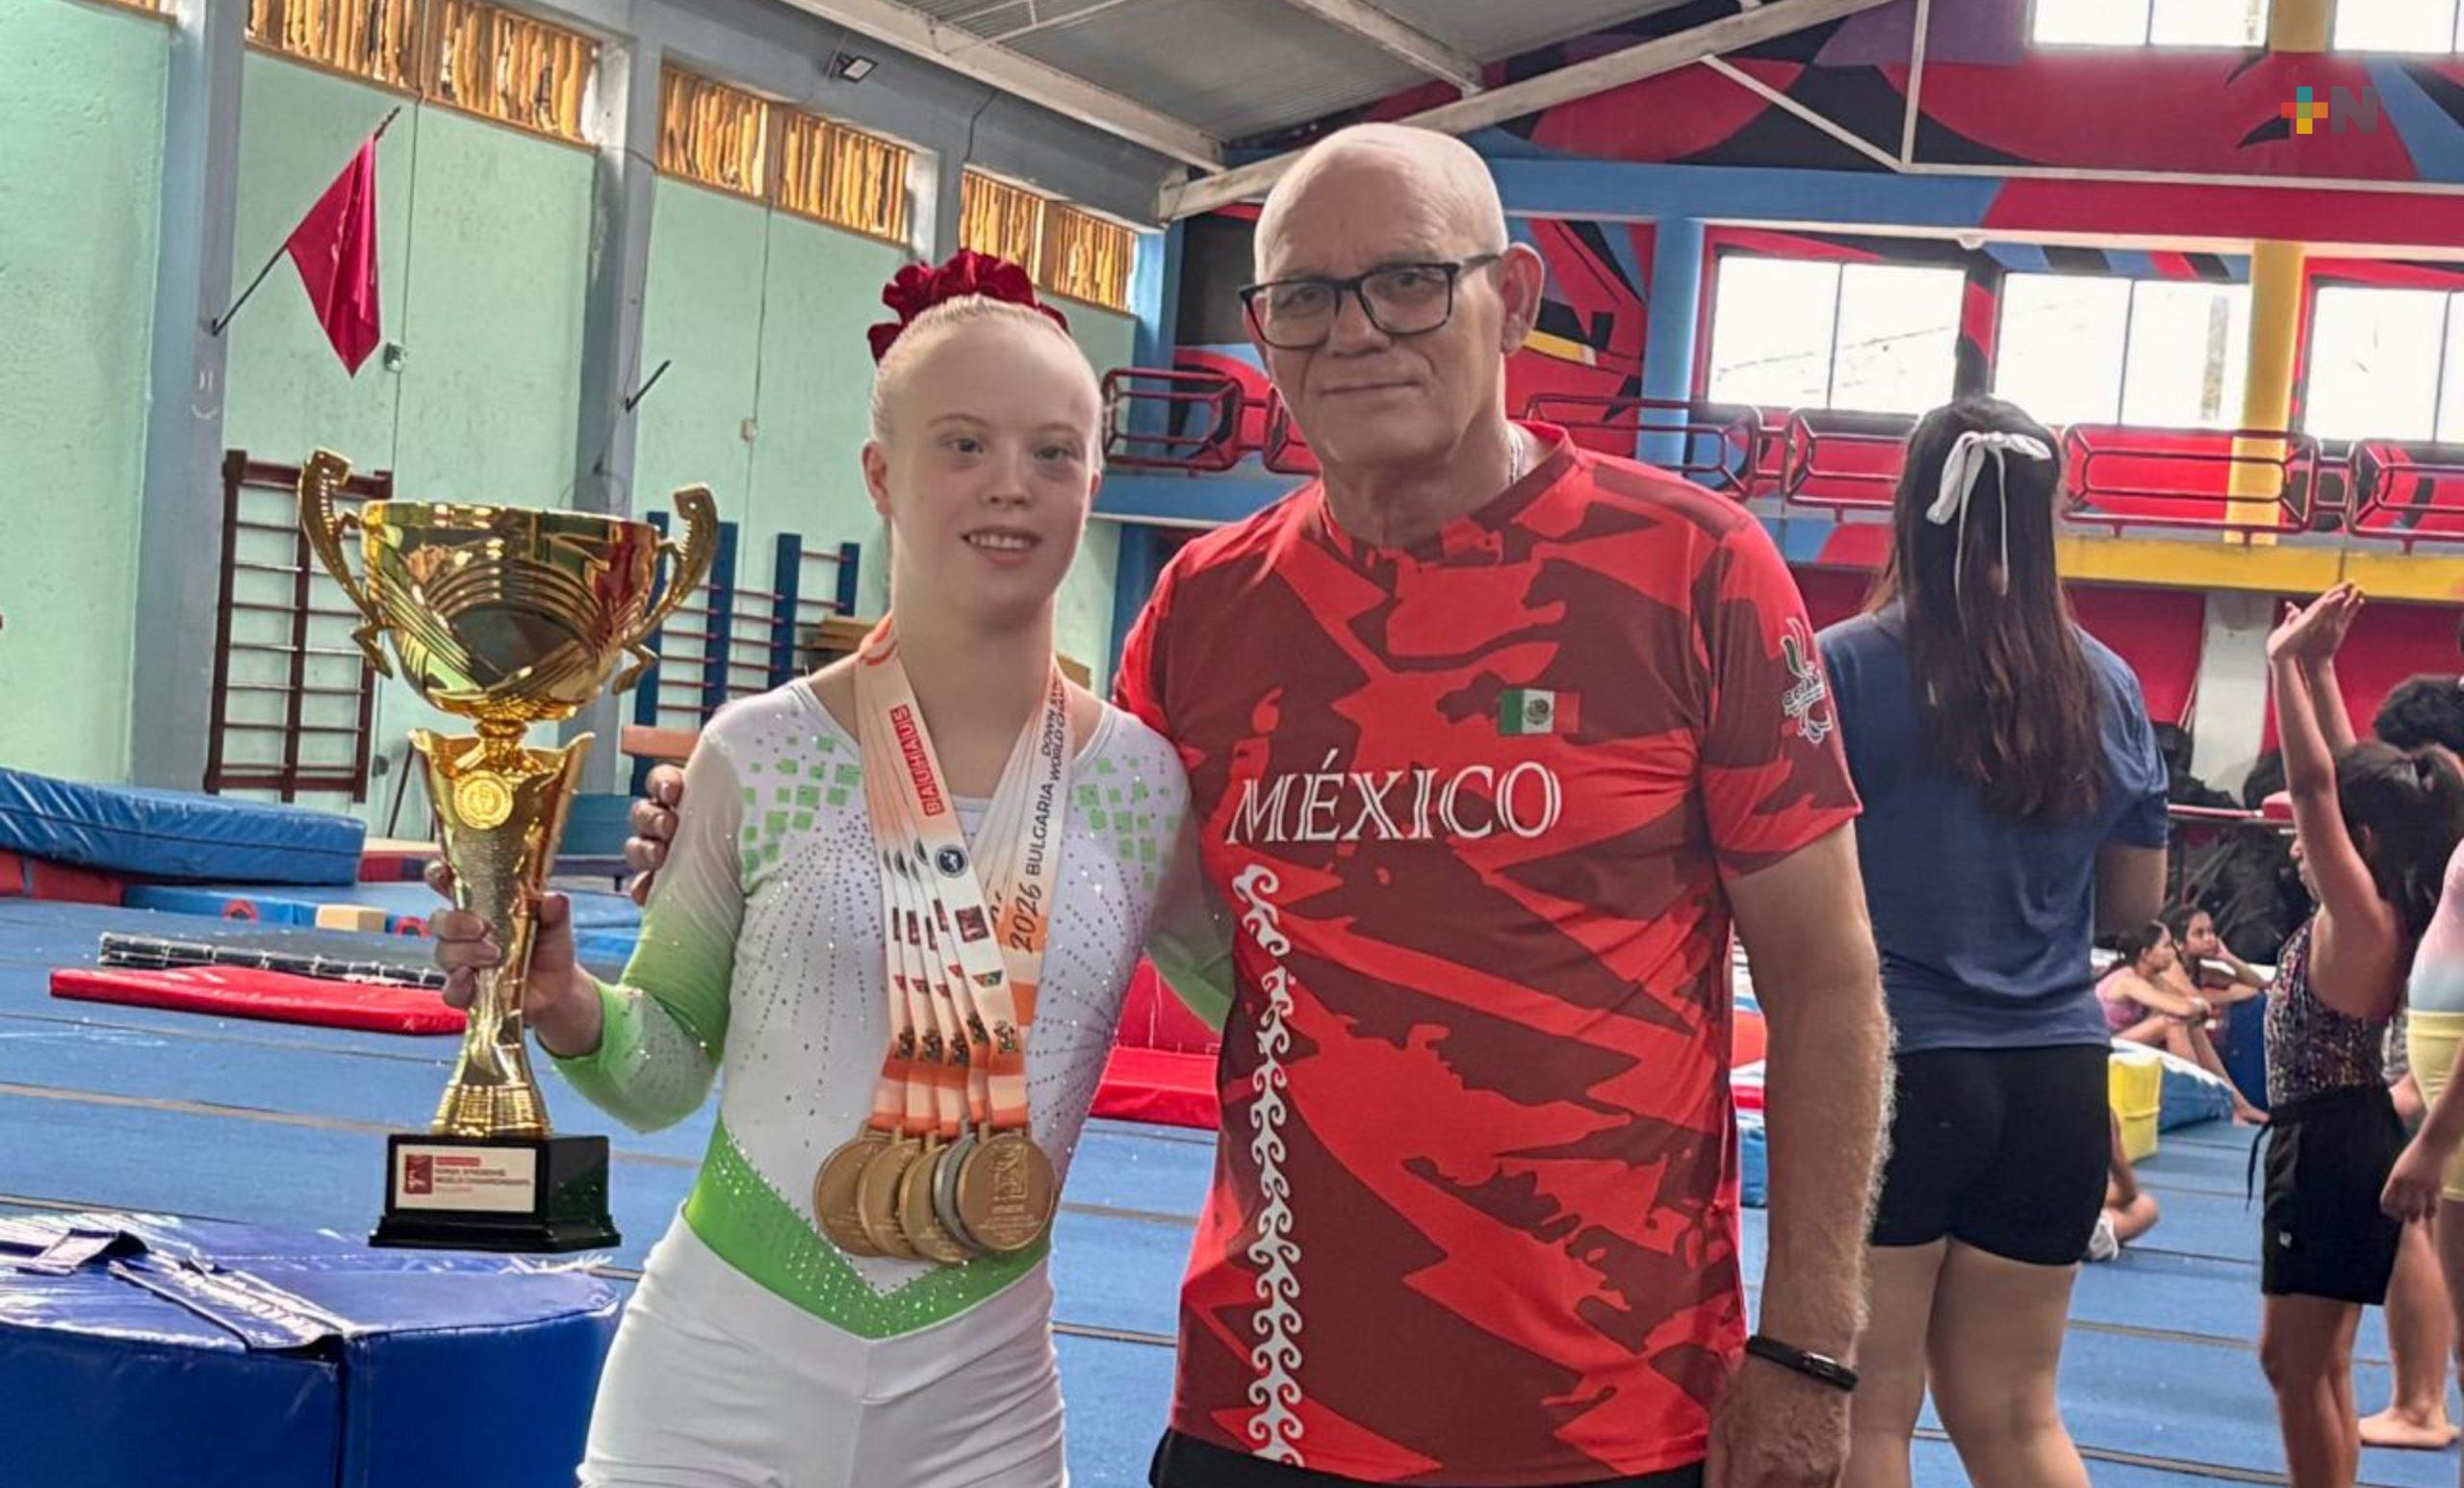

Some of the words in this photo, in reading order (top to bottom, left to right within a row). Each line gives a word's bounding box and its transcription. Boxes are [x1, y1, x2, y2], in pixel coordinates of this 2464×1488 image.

[1049, 730, 1064, 781] WORLD
[1225, 748, 1562, 845] MÉXICO
[1010, 882, 1042, 954] 2026
[1026, 783, 1054, 876] BULGARIA
